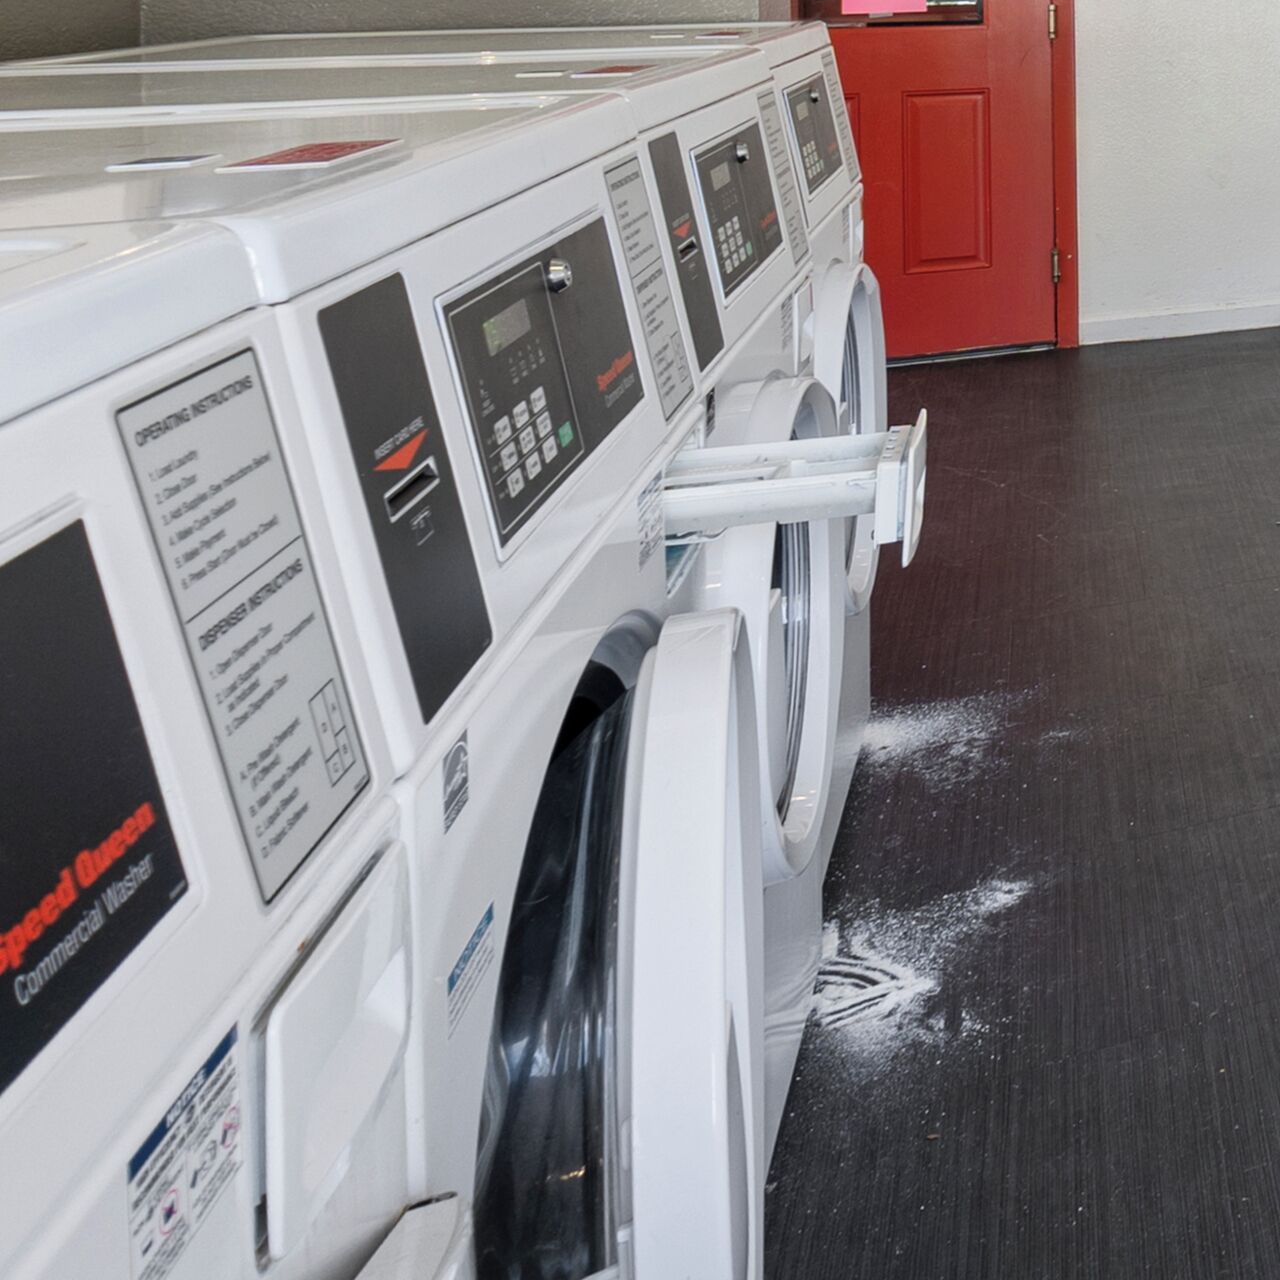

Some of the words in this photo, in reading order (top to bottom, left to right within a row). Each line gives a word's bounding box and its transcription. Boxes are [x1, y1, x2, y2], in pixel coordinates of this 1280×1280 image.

[134, 406, 190, 447] OPERATING
[189, 374, 253, 419] INSTRUCTIONS
[197, 600, 248, 652] DISPENSER
[246, 556, 303, 612] INSTRUCTIONS
[74, 801, 156, 888] Queen
[14, 899, 104, 1006] Commercial
[102, 853, 154, 915] Washer
